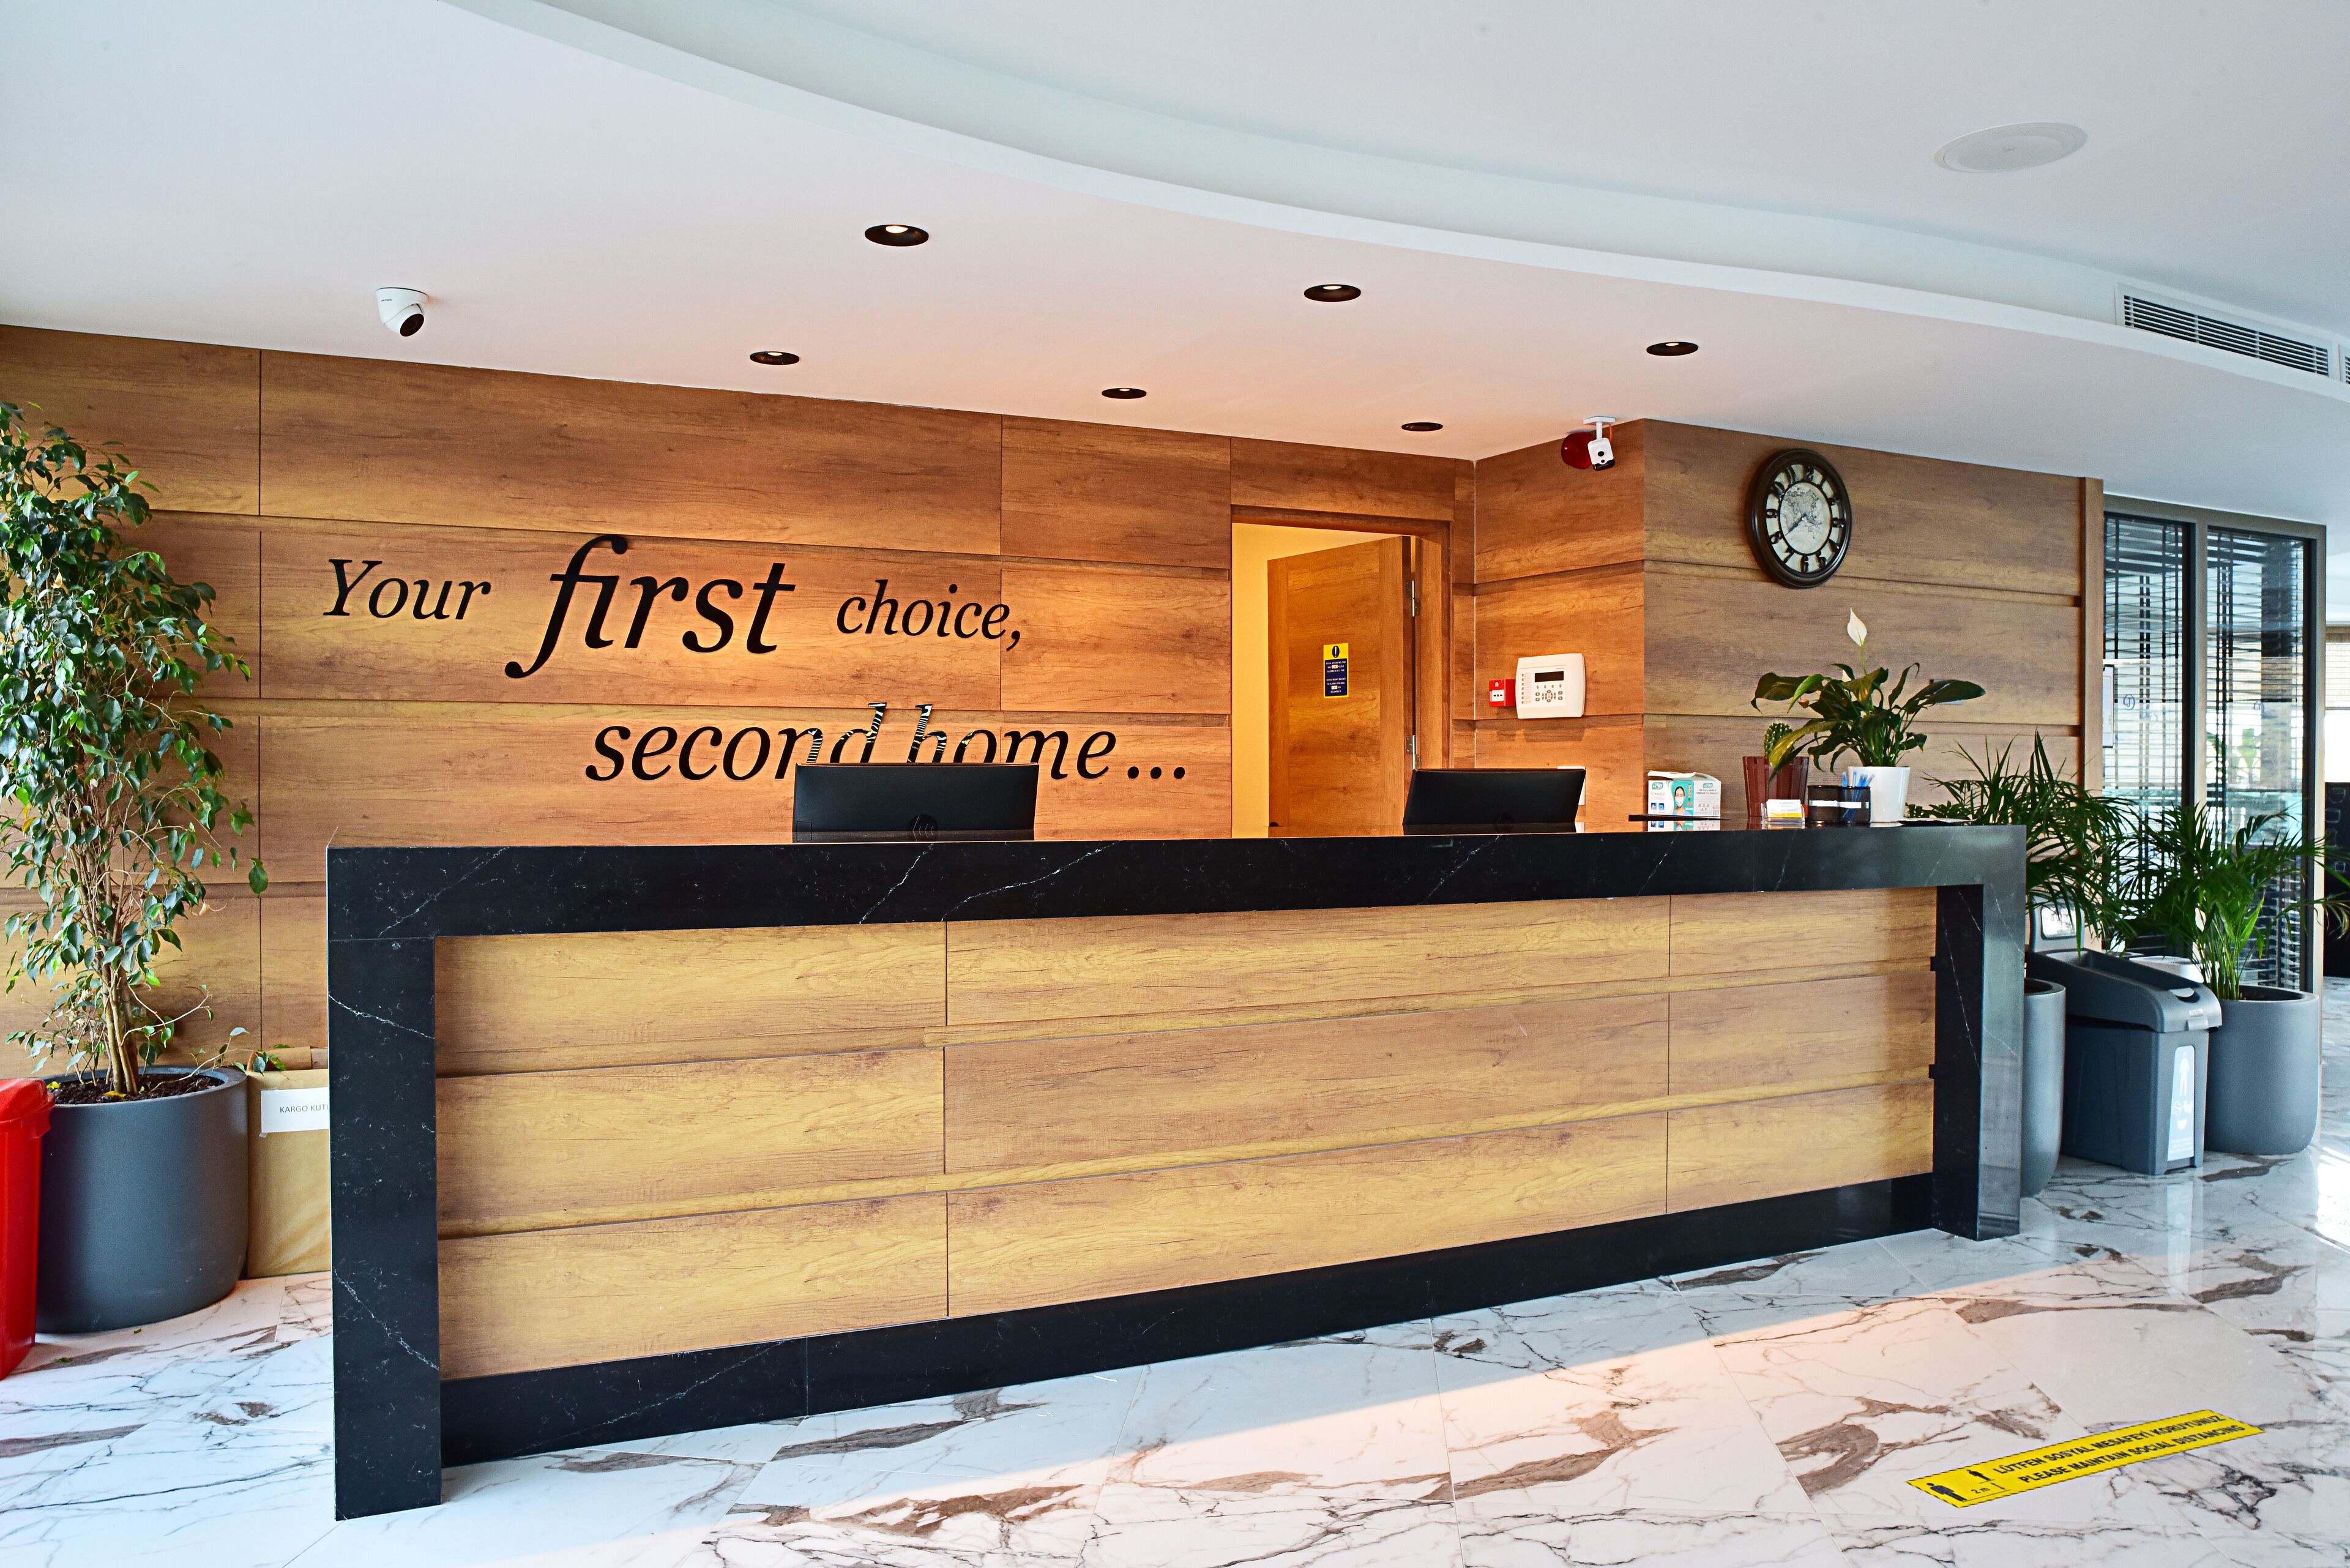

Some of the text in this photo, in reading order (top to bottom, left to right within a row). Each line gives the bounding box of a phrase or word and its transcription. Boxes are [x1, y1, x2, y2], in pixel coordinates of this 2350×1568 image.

[323, 534, 1021, 679] Your first choice,
[585, 701, 1186, 782] second home...
[280, 1105, 308, 1113] KARGO
[1993, 1457, 2047, 1474] LÜTFEN
[2043, 1446, 2096, 1462] SOSYAL
[2150, 1414, 2226, 1436] KORUYUNUZ
[2018, 1425, 2245, 1483] PLEASE MAINTAIN SOCIAL DISTANCING
